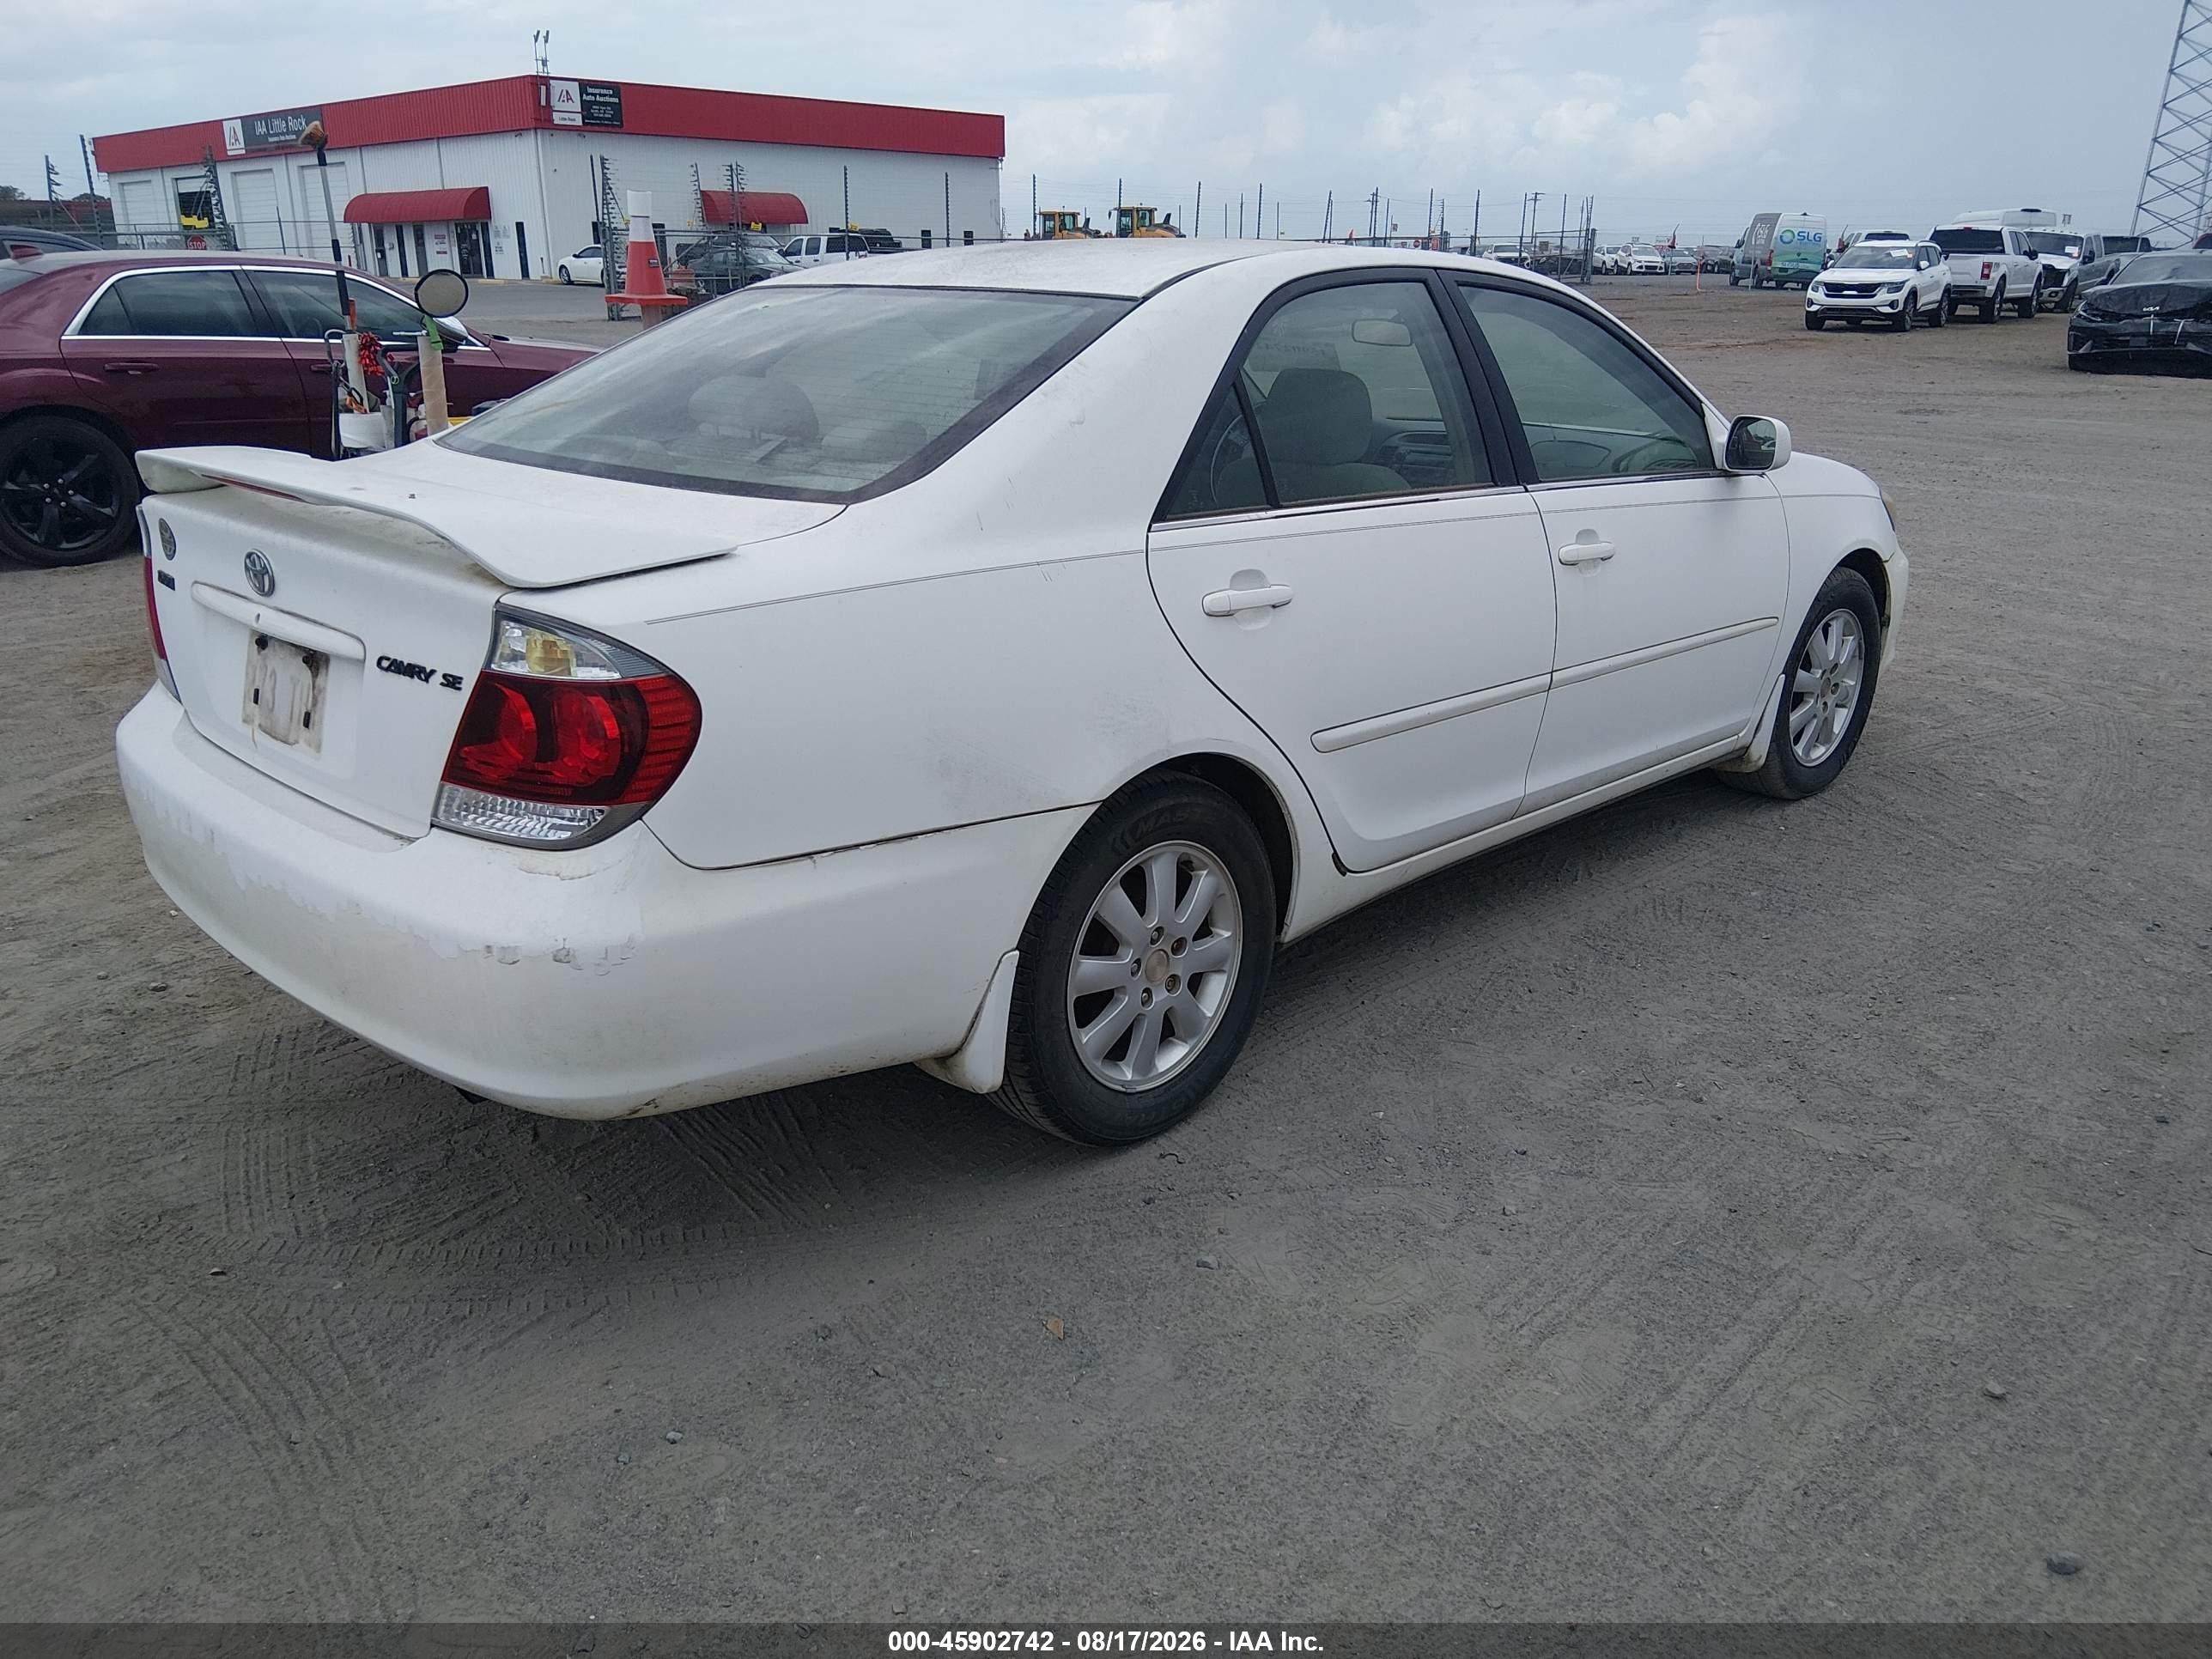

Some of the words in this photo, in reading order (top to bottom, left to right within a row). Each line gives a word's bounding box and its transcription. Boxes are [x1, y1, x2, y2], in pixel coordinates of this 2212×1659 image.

[254, 120, 267, 136] IAA
[268, 115, 287, 134] Little
[288, 114, 307, 131] Rock
[1796, 230, 1822, 242] SLG
[376, 655, 437, 684] CAMRY
[440, 672, 464, 691] SE
